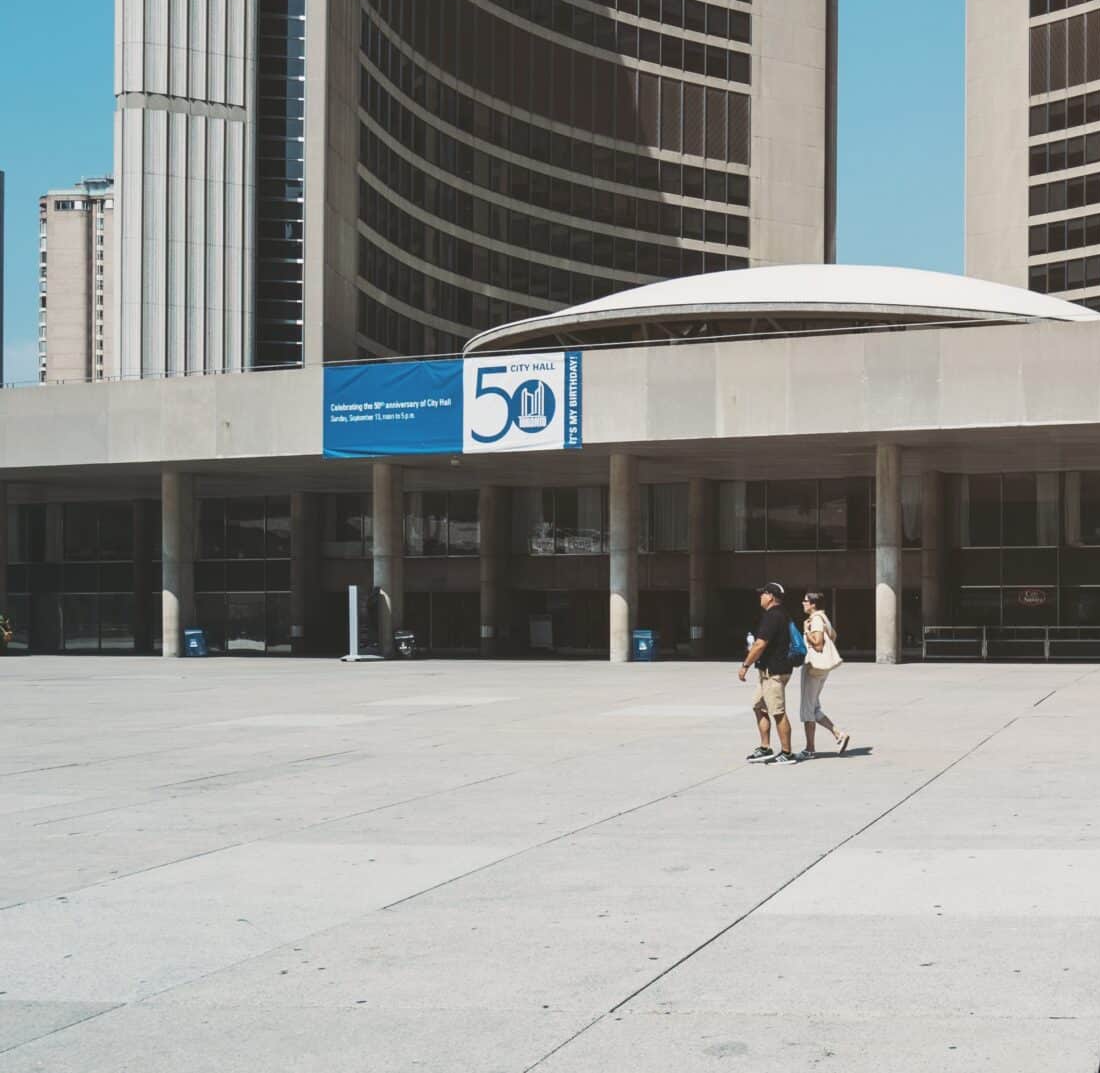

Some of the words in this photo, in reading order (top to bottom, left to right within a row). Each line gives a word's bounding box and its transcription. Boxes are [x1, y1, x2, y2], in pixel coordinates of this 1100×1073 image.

[510, 364, 530, 373] CITY
[532, 362, 556, 372] HALL
[569, 356, 578, 408] BIRTHDAY!
[330, 403, 363, 412] Celebrating
[363, 402, 373, 410] the
[385, 400, 419, 409] anniversary
[420, 399, 426, 407] of
[427, 398, 438, 407] City
[439, 398, 451, 406] Hall
[471, 365, 557, 444] 50
[569, 409, 578, 425] MY
[569, 427, 578, 445] IT'S
